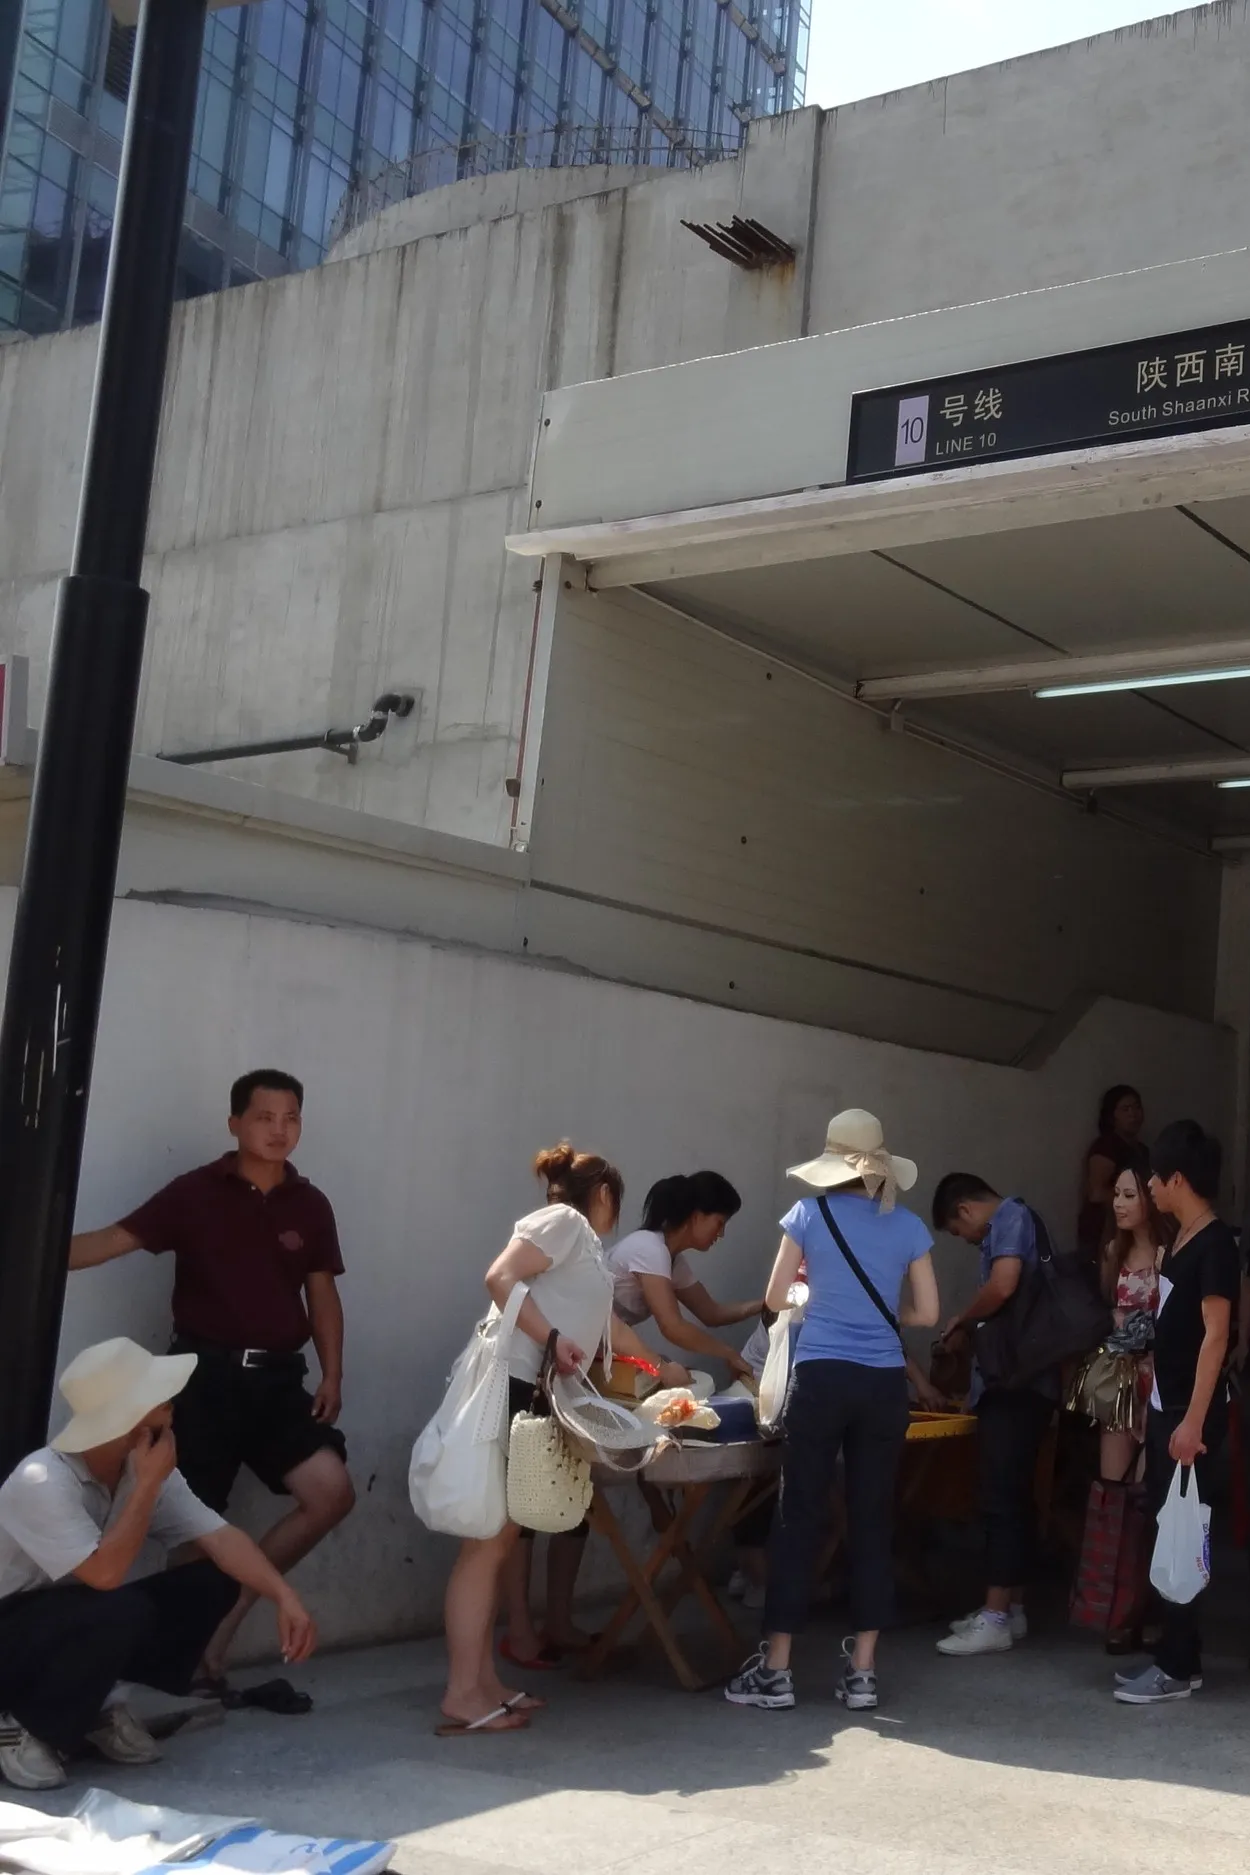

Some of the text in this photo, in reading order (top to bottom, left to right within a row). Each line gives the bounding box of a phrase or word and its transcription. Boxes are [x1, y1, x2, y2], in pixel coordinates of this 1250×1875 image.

[940, 387, 1003, 427] 号线
[1108, 405, 1158, 426] South
[1162, 390, 1232, 417] Shaanxi
[900, 416, 925, 445] 10
[936, 432, 997, 456] LINE 10
